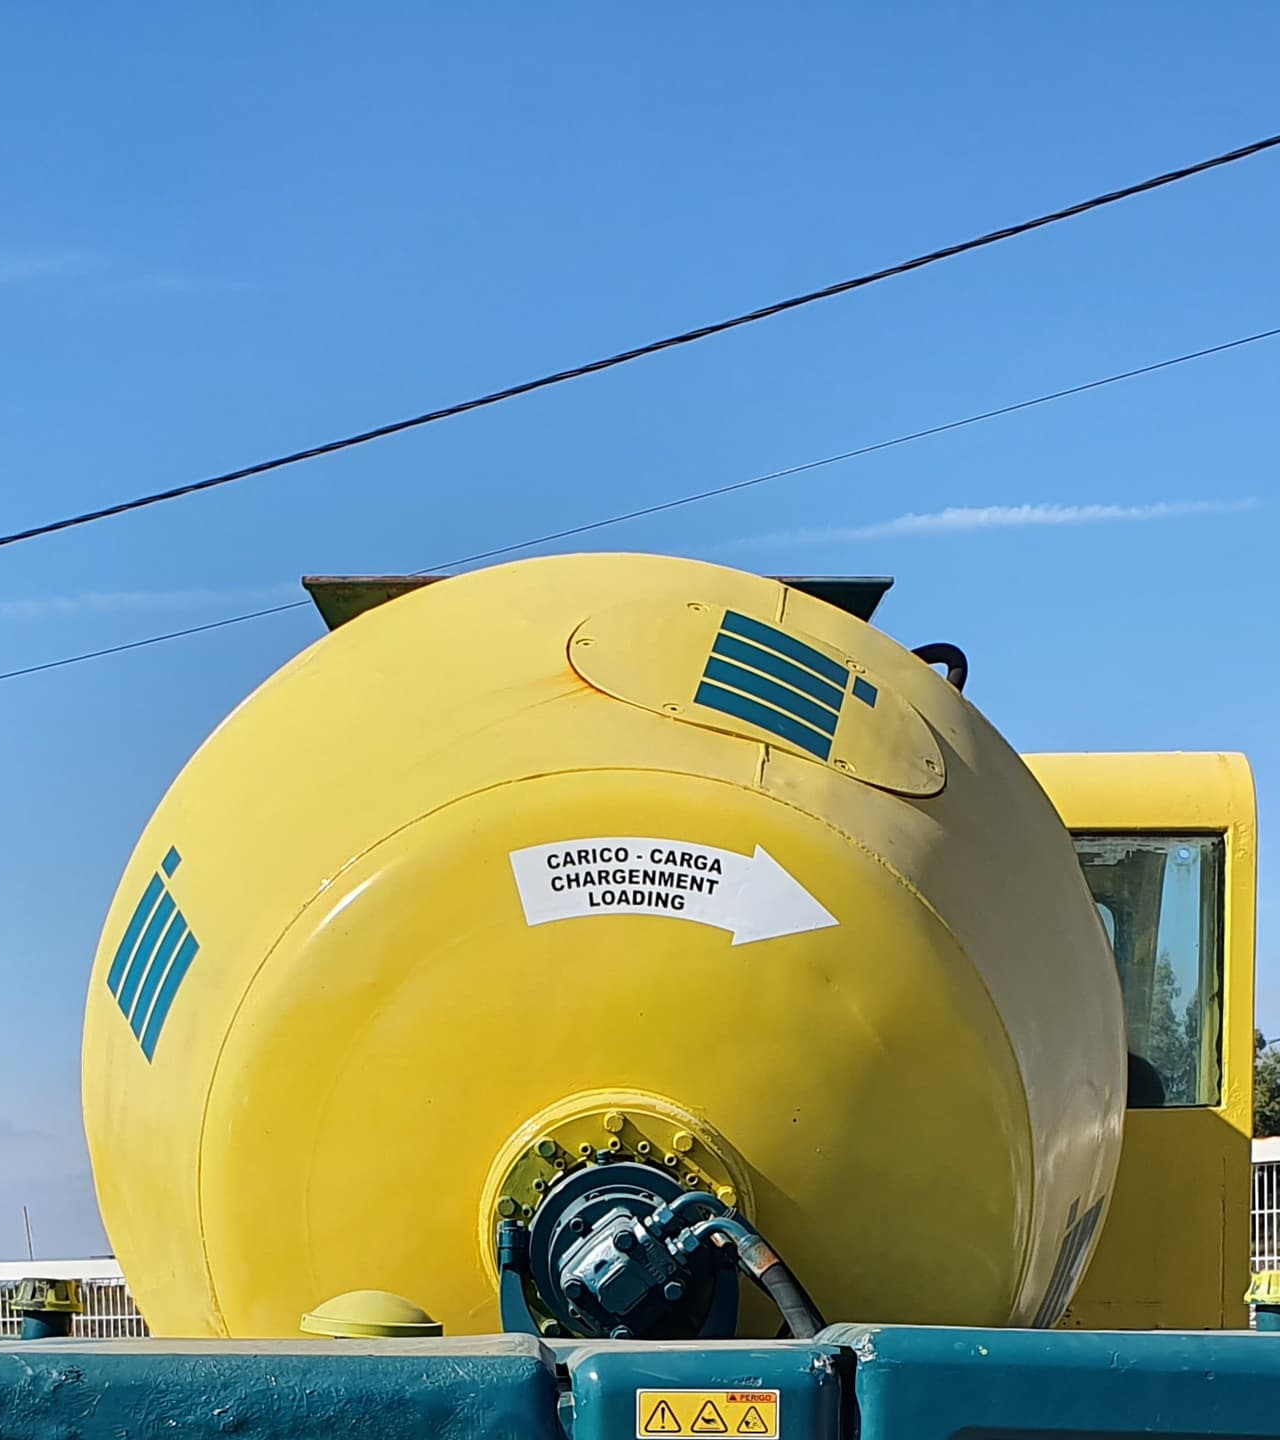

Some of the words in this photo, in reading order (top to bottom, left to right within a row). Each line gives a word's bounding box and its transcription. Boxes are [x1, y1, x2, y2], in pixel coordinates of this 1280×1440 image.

[547, 848, 629, 870] CARICO
[650, 849, 723, 875] CARGA
[550, 869, 719, 895] CHARGENMENT
[588, 890, 685, 911] LOADING
[740, 1394, 772, 1402] PERIGO
